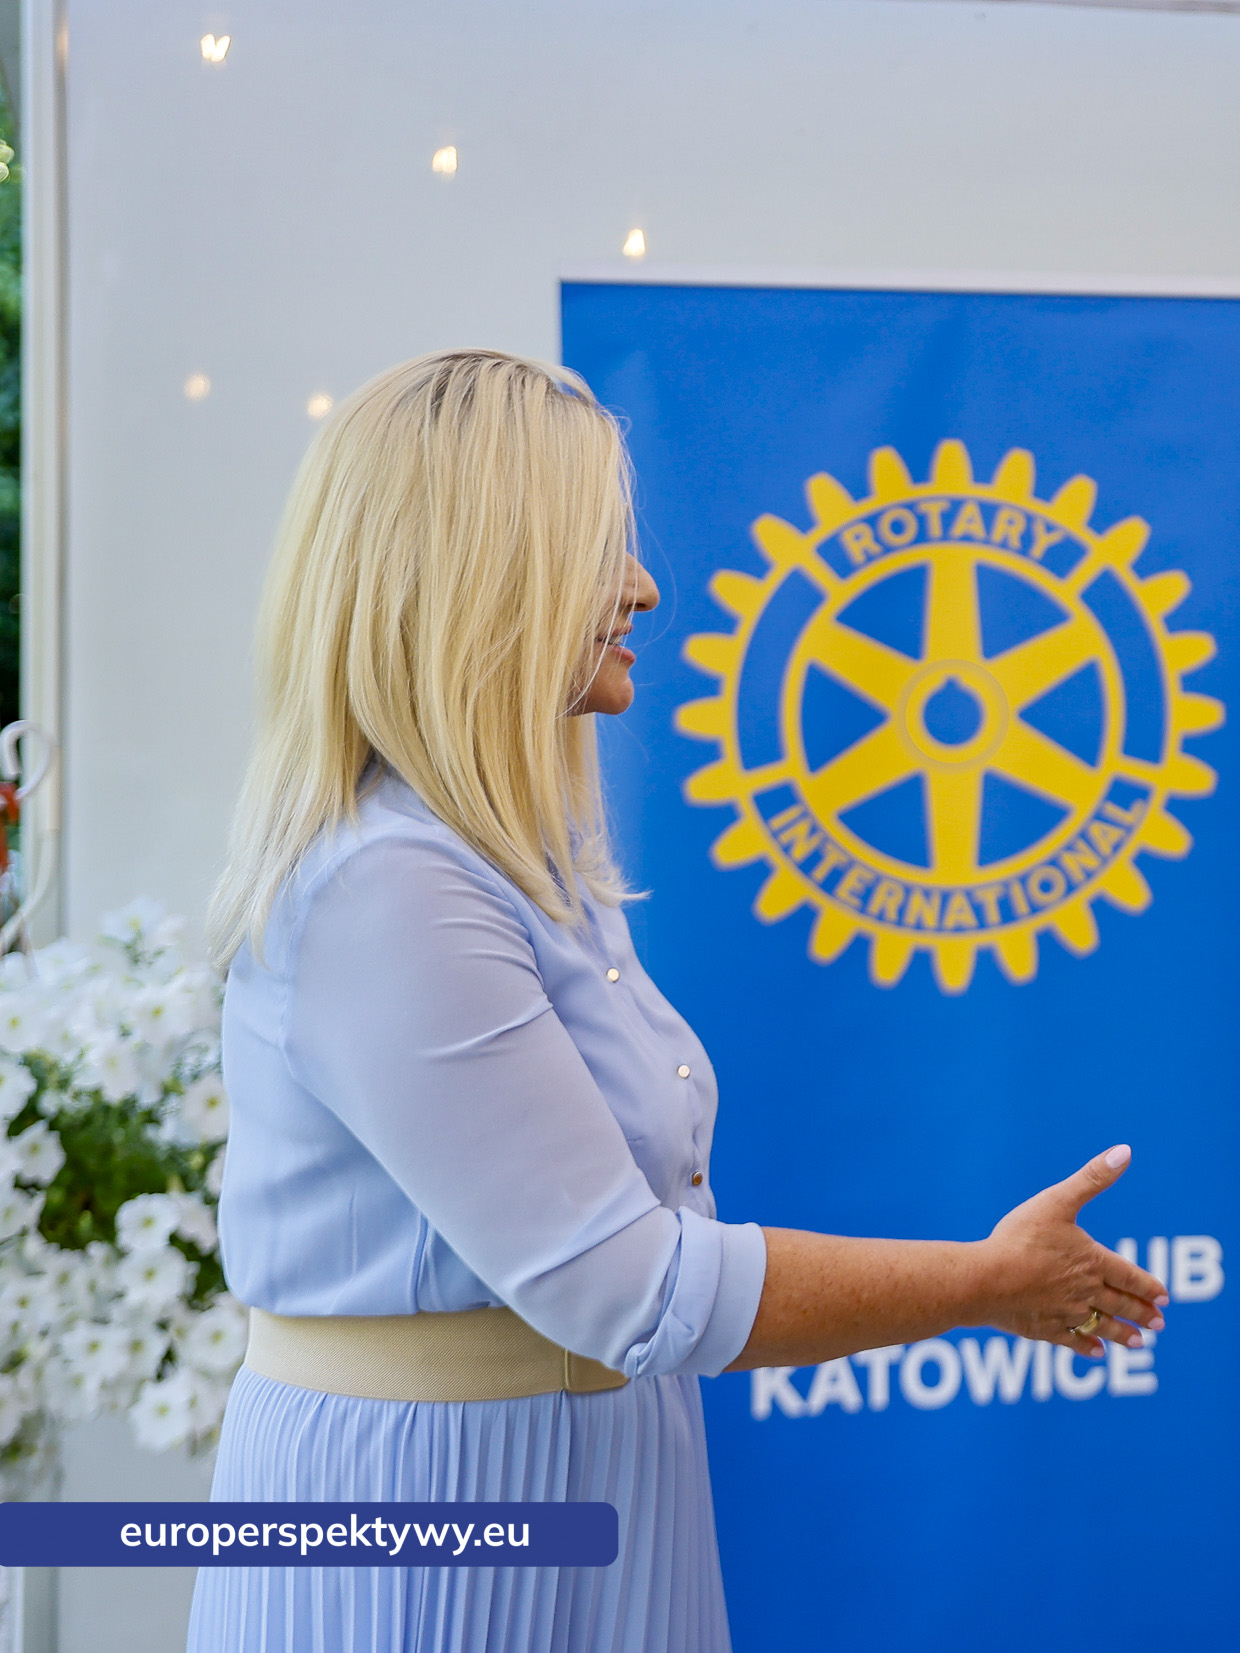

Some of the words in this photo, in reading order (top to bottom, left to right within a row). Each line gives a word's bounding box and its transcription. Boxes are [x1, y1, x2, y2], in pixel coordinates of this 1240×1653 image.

[840, 501, 1066, 563] ROTARY
[769, 799, 1147, 929] INTERNATIONAL
[750, 1329, 1158, 1420] KATOWICE
